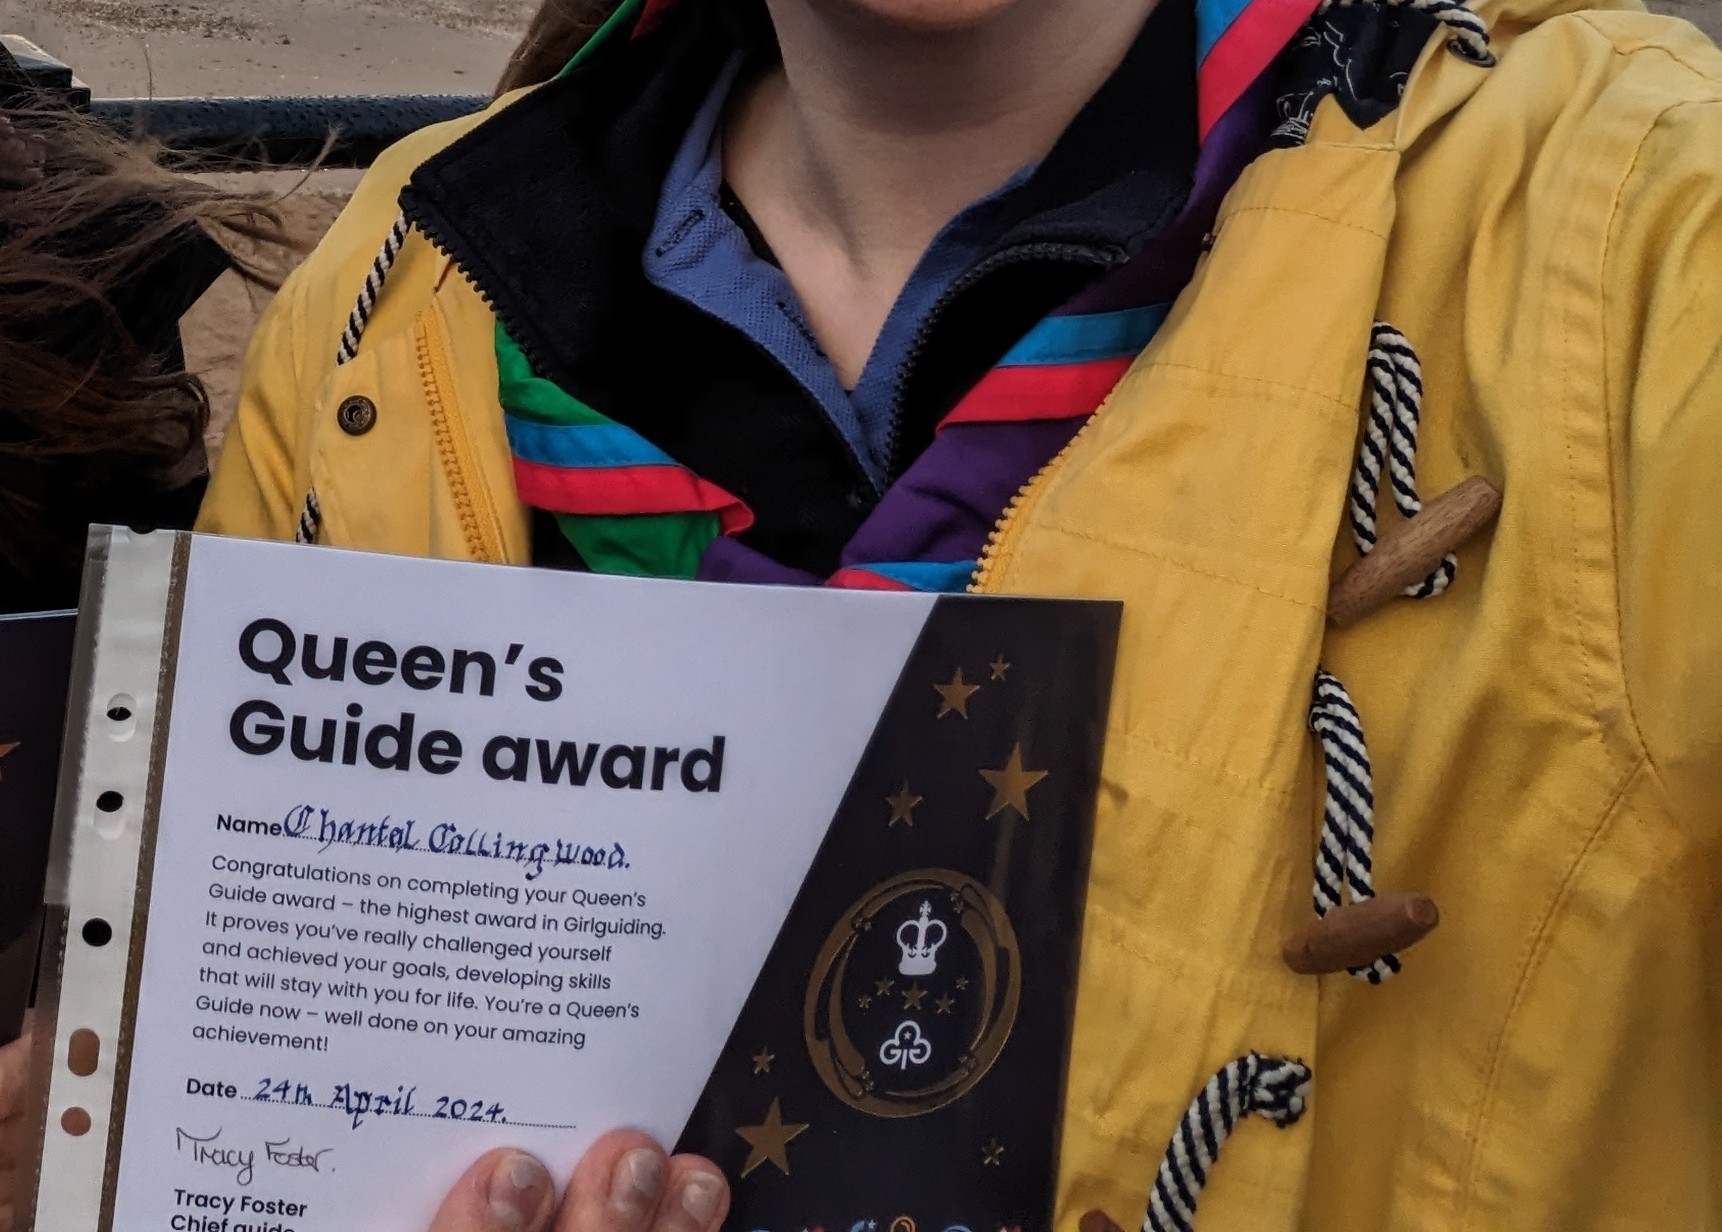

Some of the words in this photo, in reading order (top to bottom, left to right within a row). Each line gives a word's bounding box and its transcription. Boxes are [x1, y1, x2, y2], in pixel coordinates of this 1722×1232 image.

[238, 618, 564, 702] Queen’s
[230, 699, 462, 775] Guide
[482, 735, 726, 792] award
[217, 814, 282, 836] Name
[283, 805, 419, 853] Chantal
[212, 855, 371, 886] Congratulations
[377, 876, 401, 889] on
[408, 878, 519, 904] completing
[525, 888, 567, 905] your
[572, 889, 646, 907] Queen’s
[206, 911, 217, 927] It
[222, 916, 288, 934] proves
[296, 923, 358, 941] you’ve
[364, 930, 418, 952] really
[423, 934, 532, 960] challenged
[538, 946, 612, 963] yourself
[209, 883, 266, 903] Guide
[272, 893, 335, 911] award
[360, 899, 391, 916] the
[397, 902, 469, 925] highest
[475, 913, 536, 929] award
[542, 914, 558, 931] in
[564, 916, 666, 940] Girlguiding.
[200, 967, 239, 986] that
[245, 972, 275, 989] will
[280, 977, 322, 998] stay
[328, 981, 367, 999] with
[374, 988, 409, 1005] you
[416, 988, 442, 1006] for
[447, 991, 478, 1010] life.
[485, 995, 543, 1014] You’re
[548, 1003, 560, 1016] a
[566, 1002, 639, 1019] Queen’s
[202, 942, 241, 958] and
[247, 946, 338, 968] achieved
[344, 956, 387, 974] your
[393, 962, 449, 981] goals,
[456, 965, 563, 992] developing
[568, 973, 611, 990] skills
[193, 1025, 328, 1052] achievement!
[196, 995, 253, 1015] Guide
[260, 1004, 301, 1020] now
[325, 1010, 362, 1026] well
[368, 1013, 418, 1032] done
[424, 1021, 448, 1034] on
[454, 1024, 498, 1040] your
[502, 1028, 585, 1050] amazing
[186, 1078, 237, 1098] Date
[330, 1083, 416, 1129] April
[171, 1214, 228, 1232] Chief
[174, 1188, 235, 1216] Tracy
[240, 1196, 307, 1218] Foster
